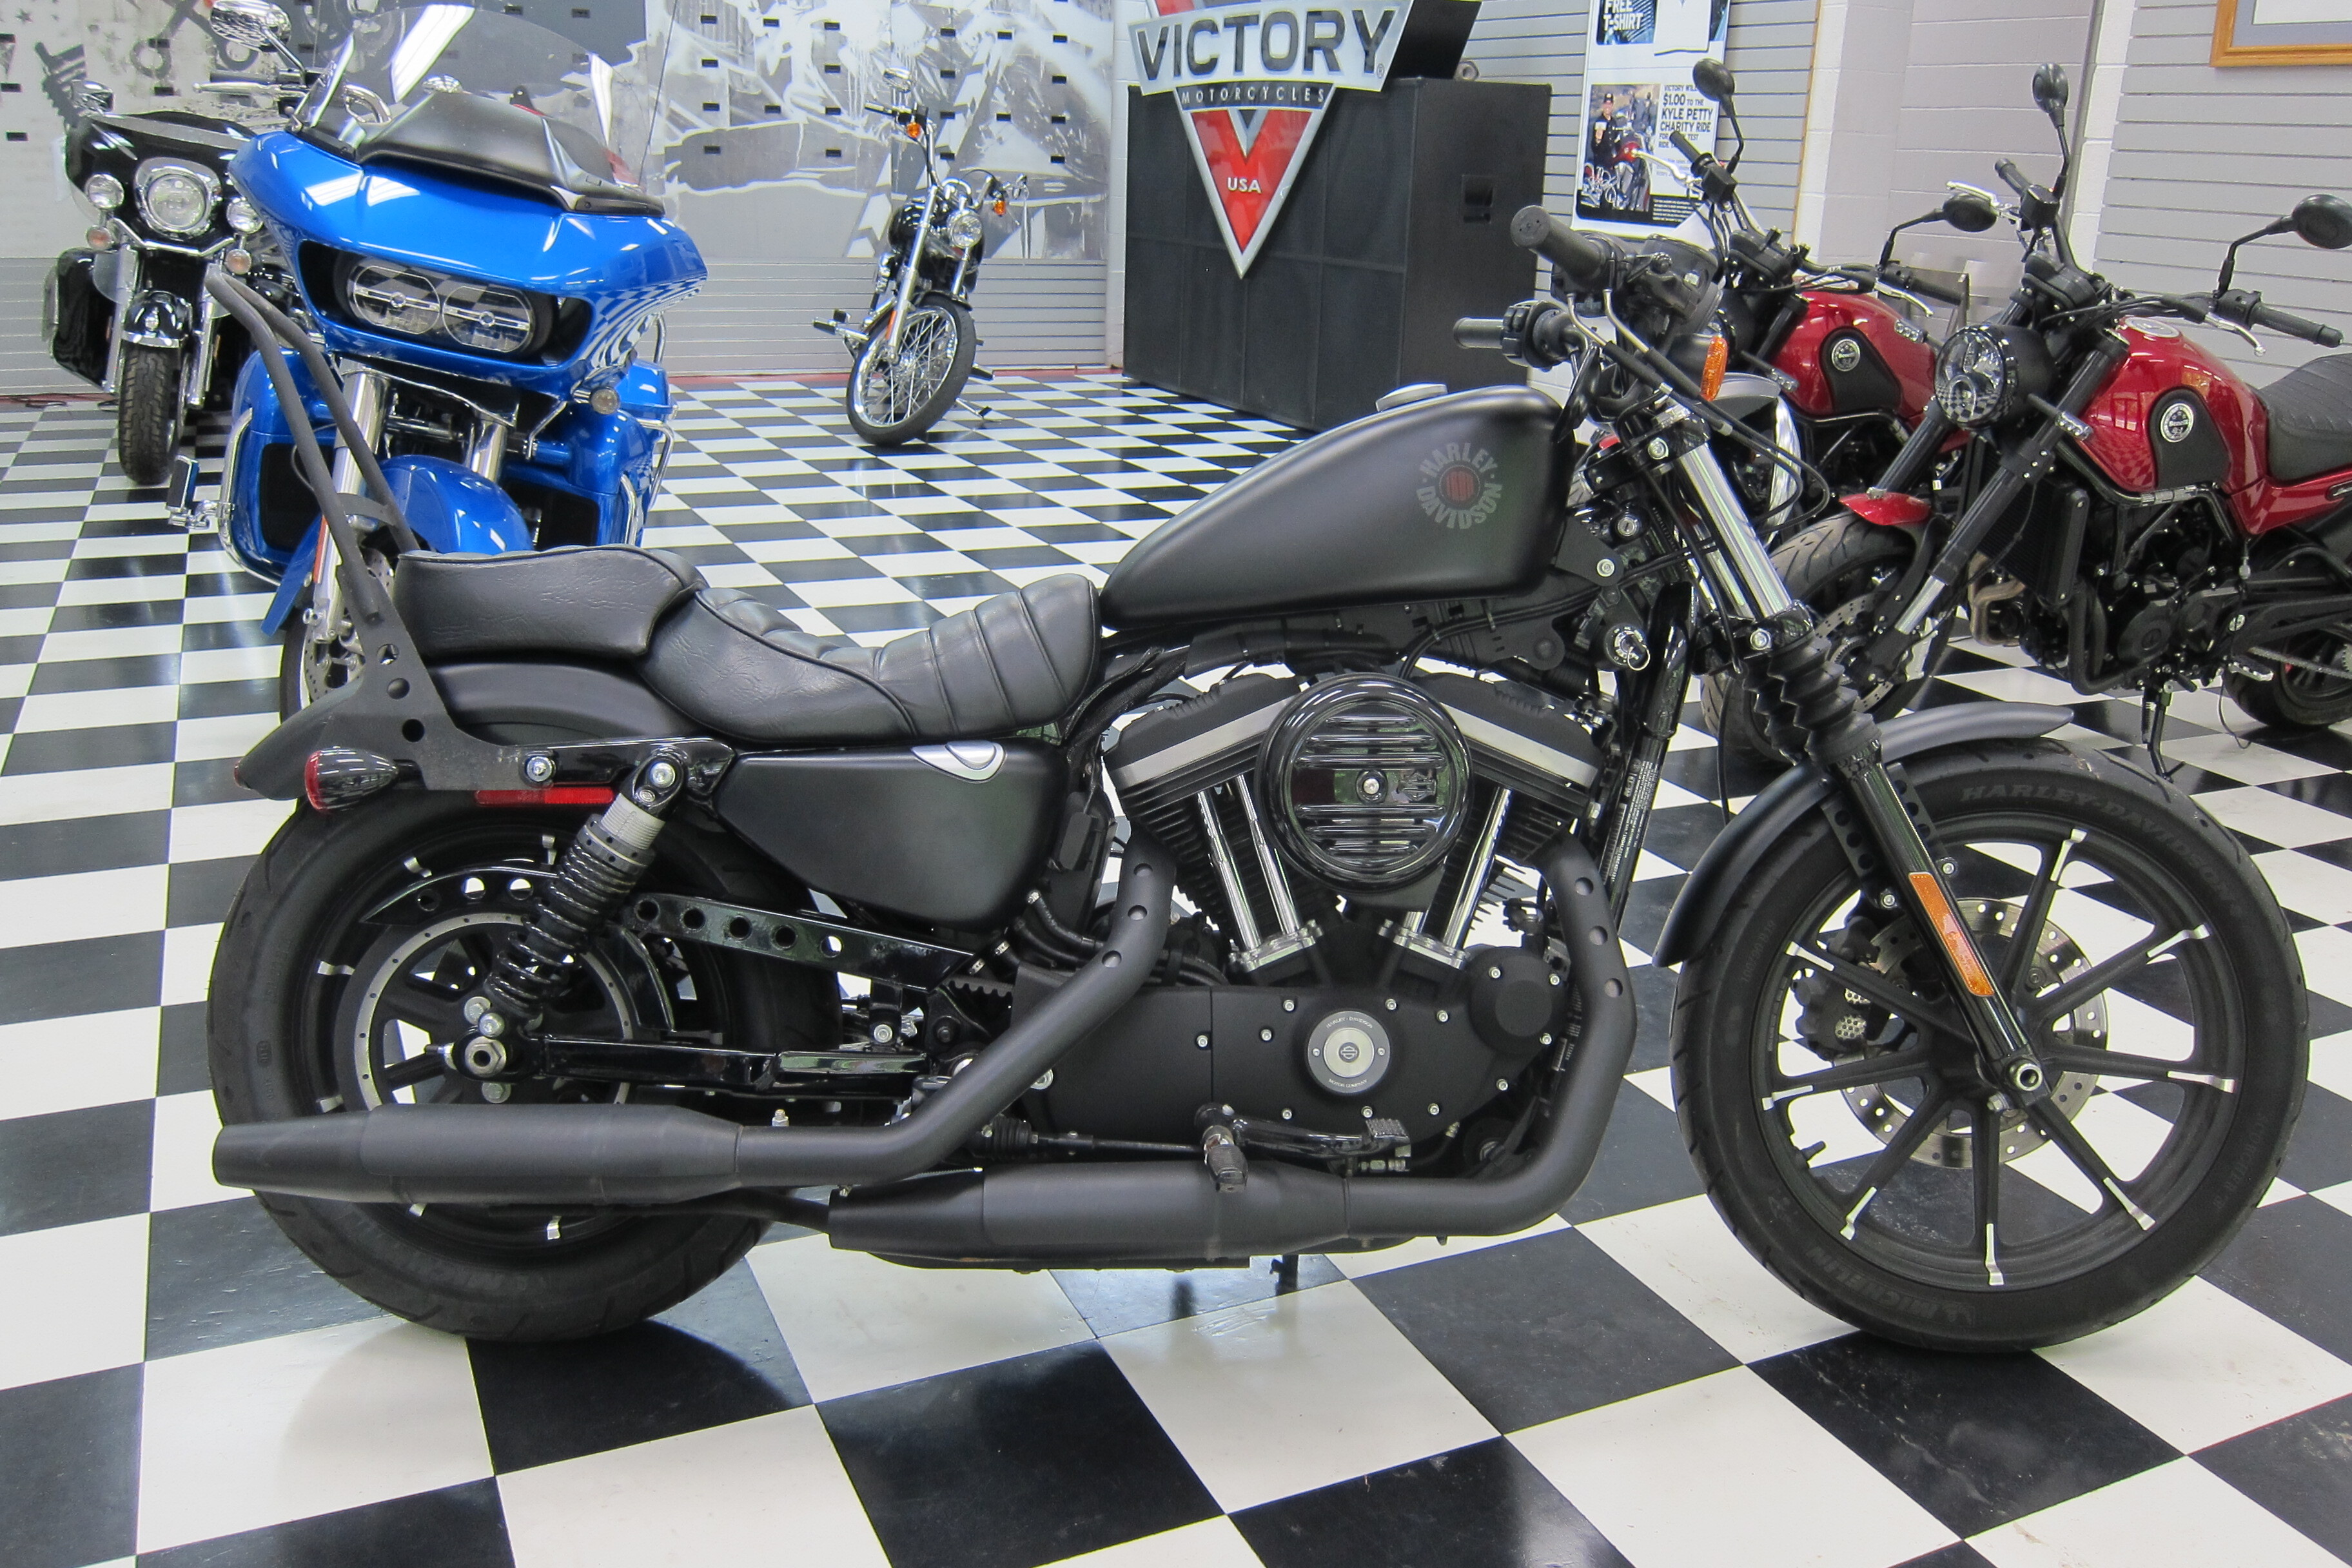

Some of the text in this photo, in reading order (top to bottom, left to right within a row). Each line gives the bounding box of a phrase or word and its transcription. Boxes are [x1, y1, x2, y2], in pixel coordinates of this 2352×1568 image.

[1604, 0, 1633, 14] FREE
[1603, 13, 1643, 31] T-SHIRT
[1136, 9, 1398, 81] VICTORY
[1182, 86, 1325, 104] MOTORCYCLES
[1663, 93, 1685, 106] $1.00
[1661, 108, 1713, 121] KYLE PETTY
[1660, 121, 1712, 133] CHARITY RIDE
[1227, 176, 1262, 195] USA
[1419, 442, 1498, 478] HARLEY
[1416, 482, 1503, 529] DAVIDSON
[1328, 1078, 1346, 1088] MOTOR
